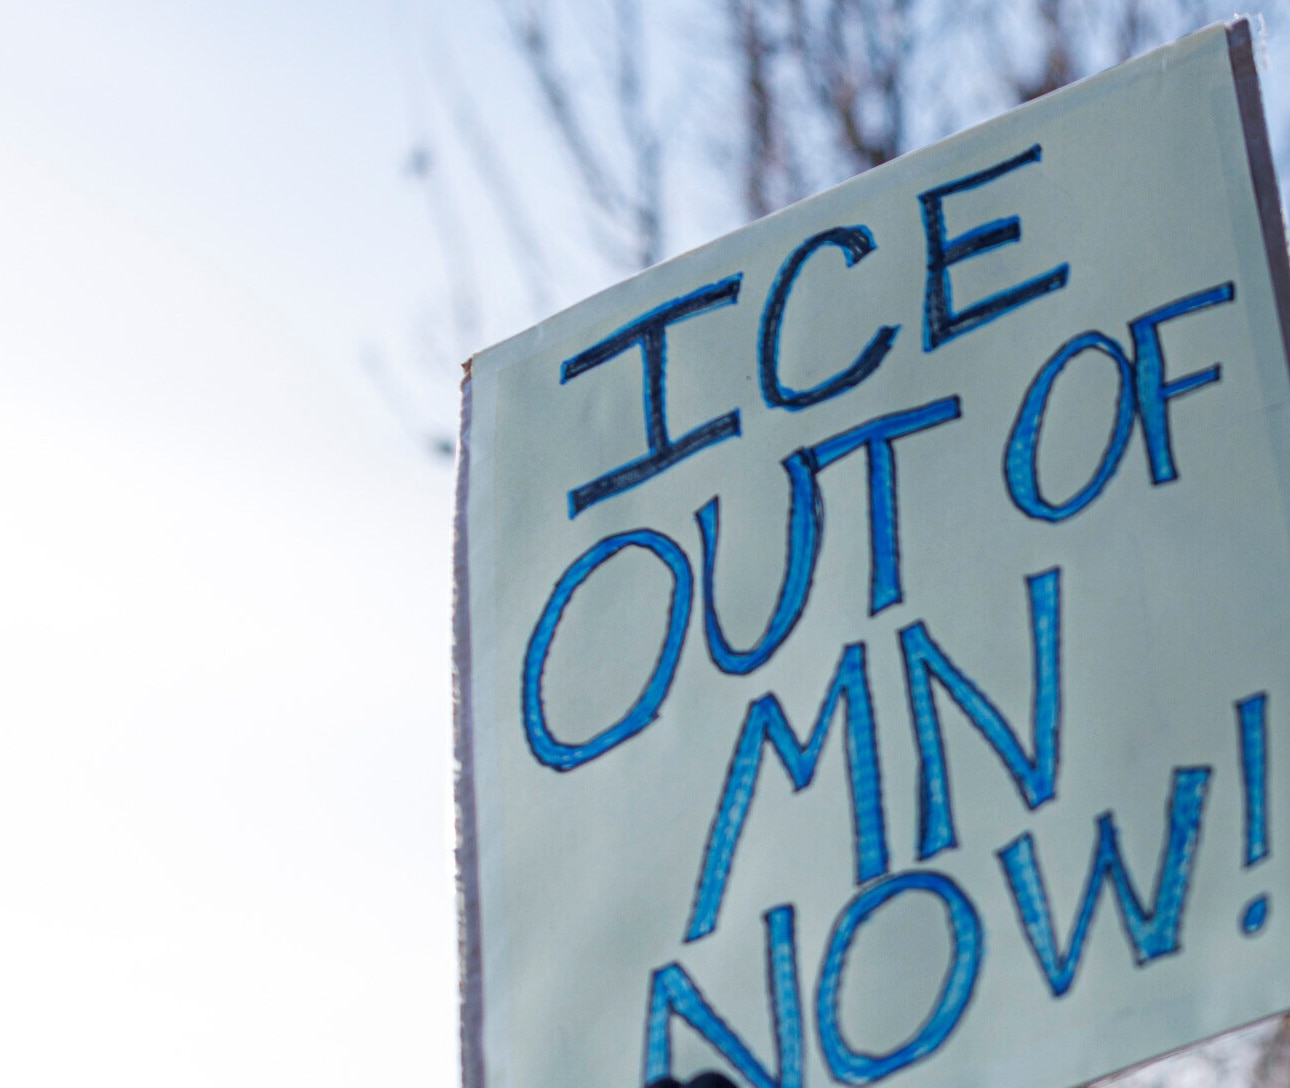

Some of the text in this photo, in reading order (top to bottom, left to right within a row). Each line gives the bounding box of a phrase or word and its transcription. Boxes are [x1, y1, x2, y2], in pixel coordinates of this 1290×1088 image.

[561, 145, 1069, 518] ICE
[522, 282, 1236, 772] OUT OF
[684, 567, 1062, 944] MN
